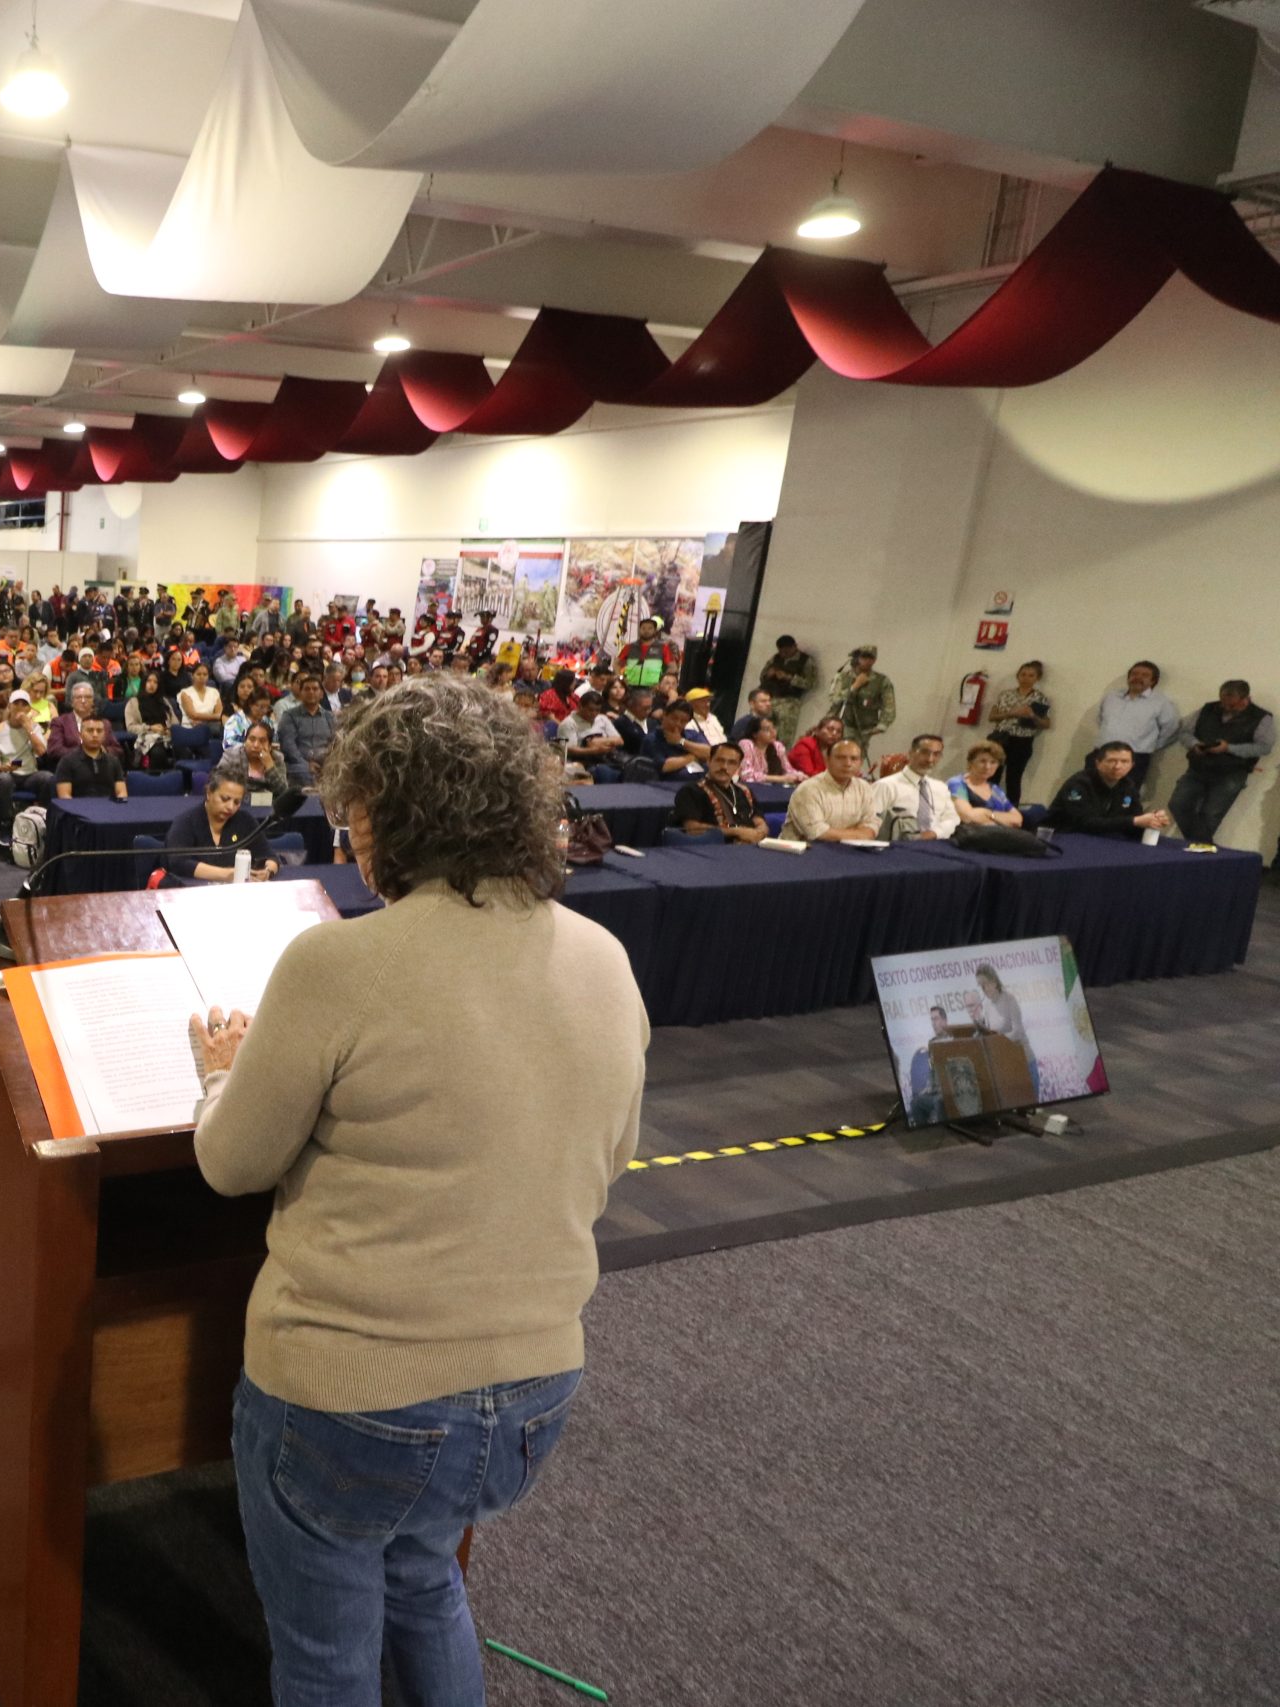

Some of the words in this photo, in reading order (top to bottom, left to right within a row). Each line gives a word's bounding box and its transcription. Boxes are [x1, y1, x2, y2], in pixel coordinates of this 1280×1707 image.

[877, 969, 908, 988] SEXTO
[909, 961, 962, 983] CONGRESO
[1045, 945, 1059, 964] DE
